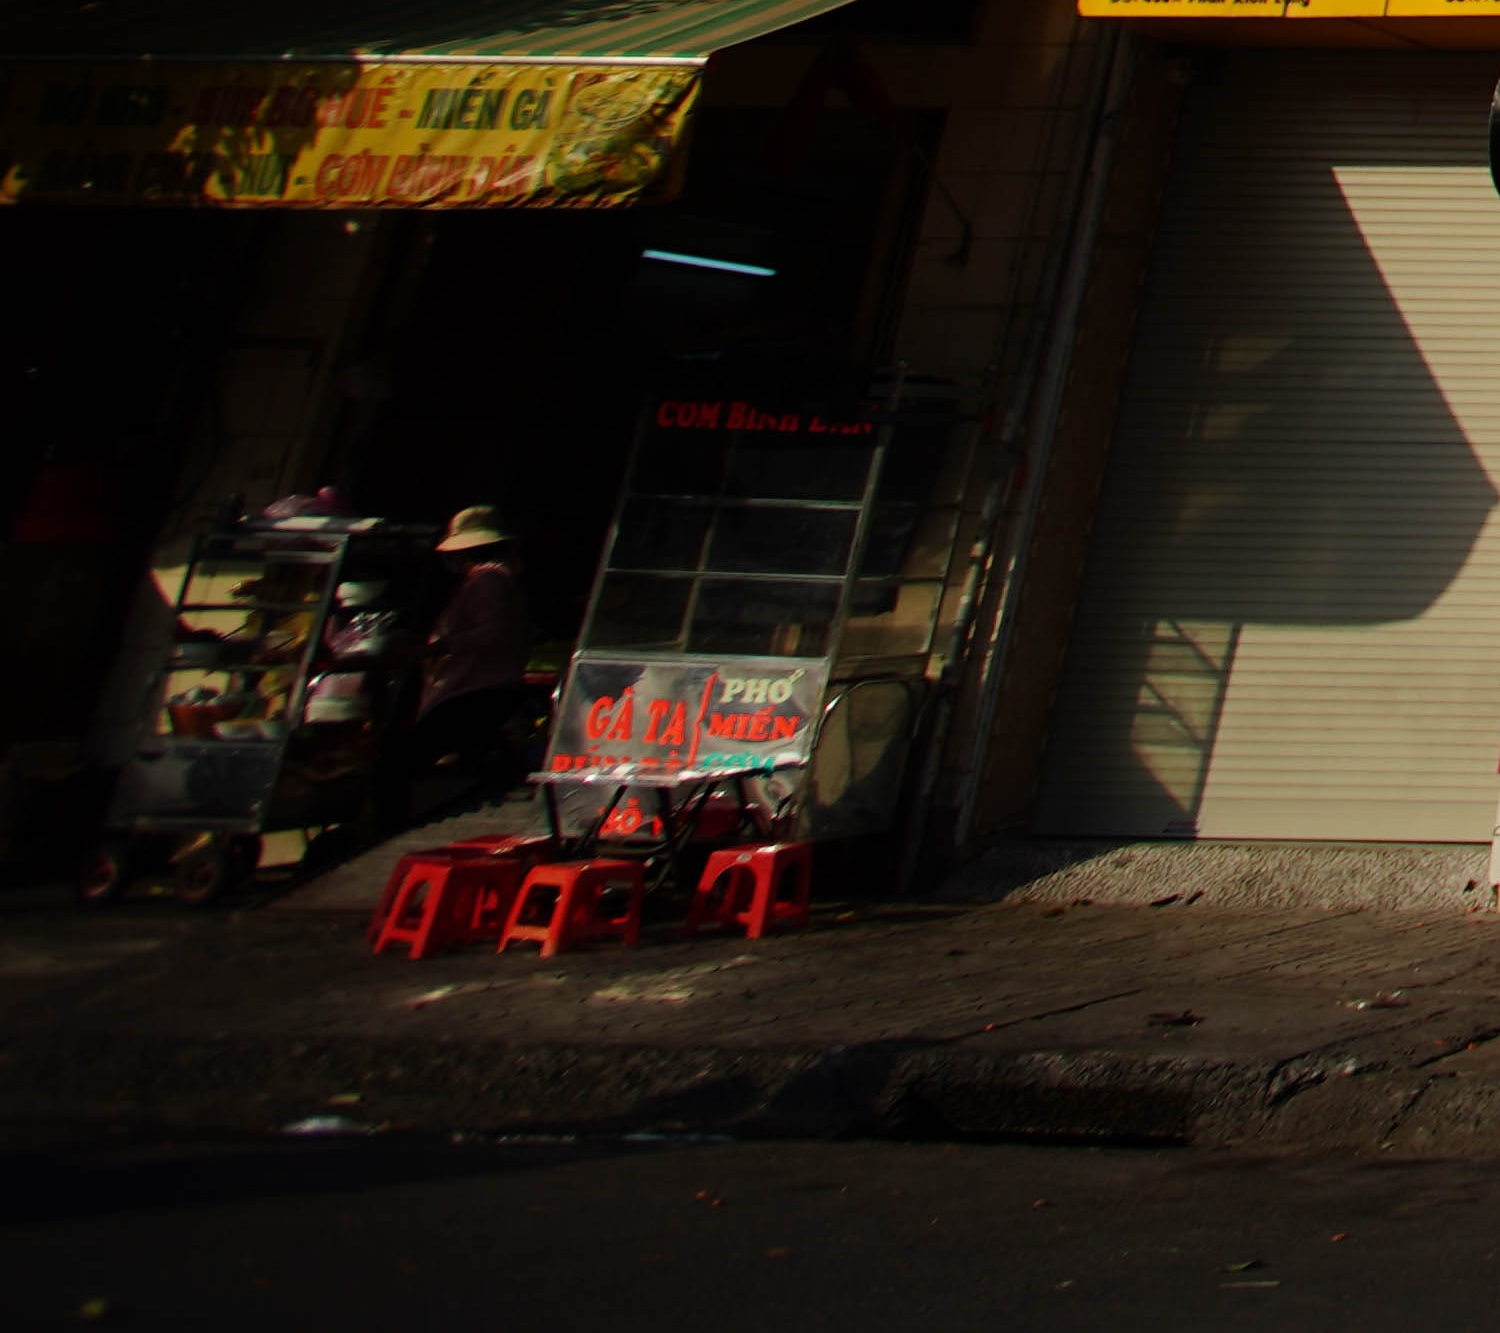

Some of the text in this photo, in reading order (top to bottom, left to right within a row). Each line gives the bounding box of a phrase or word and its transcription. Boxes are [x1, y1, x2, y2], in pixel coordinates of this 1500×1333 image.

[416, 71, 506, 130] MIẾN
[509, 77, 556, 130] GÀ
[315, 147, 389, 198] CƠM
[644, 699, 686, 746] TA
[707, 704, 802, 741] MIẾN
